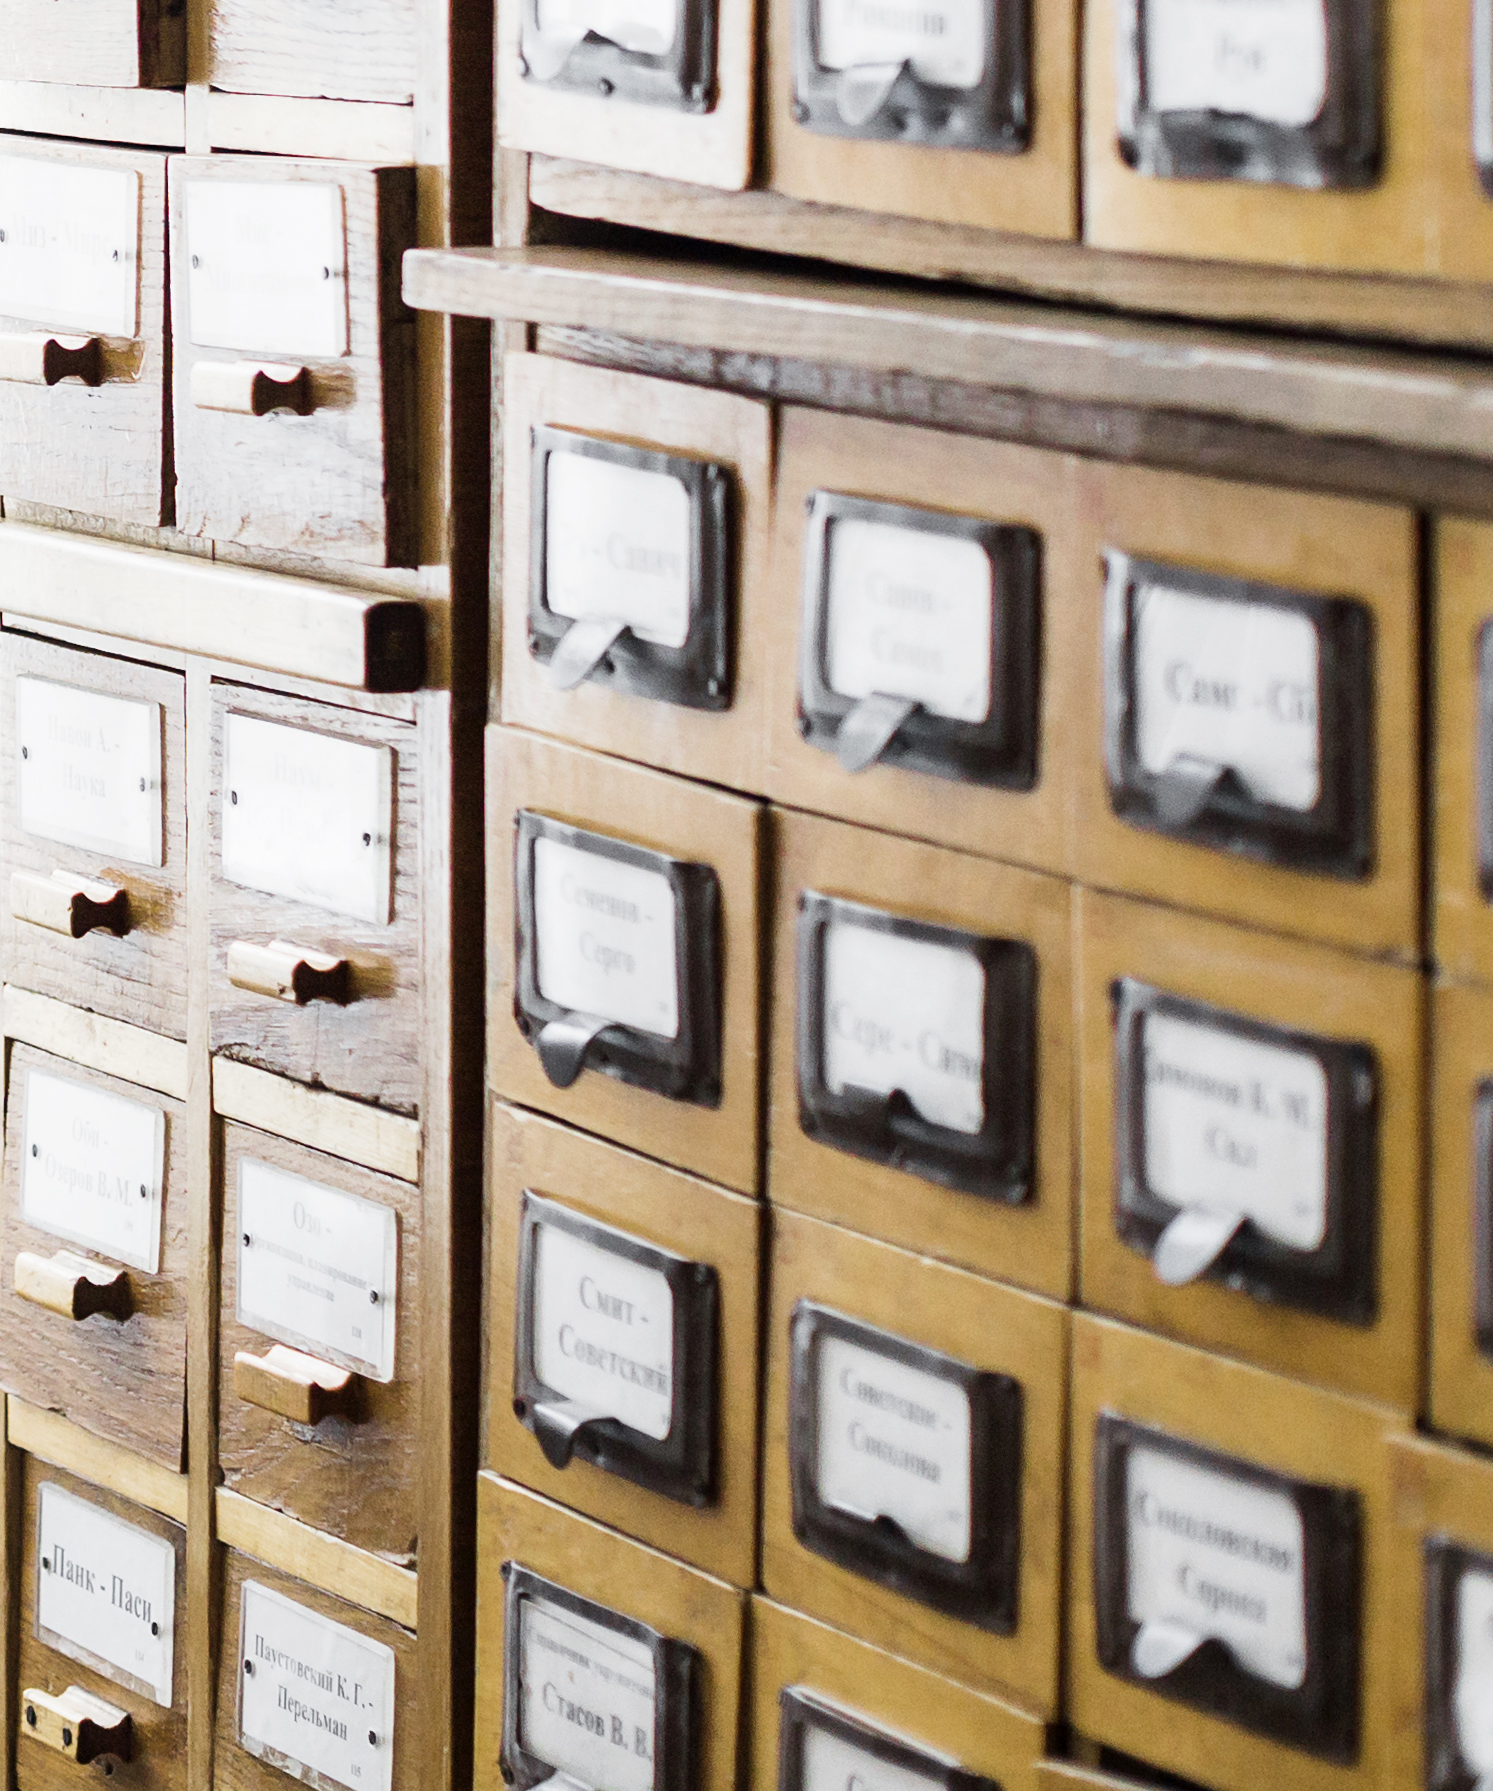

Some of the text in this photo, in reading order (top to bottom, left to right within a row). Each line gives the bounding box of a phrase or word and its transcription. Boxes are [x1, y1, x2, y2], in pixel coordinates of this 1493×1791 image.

[45, 1151, 94, 1194] Озеров
[579, 1275, 634, 1326] Смит
[52, 1543, 95, 1595] Панк
[111, 1574, 152, 1624] Паси
[254, 1633, 333, 1693] Паустовский
[337, 1674, 350, 1701] К.
[278, 1684, 347, 1741] Перельман
[542, 1681, 606, 1738] Стасов
[611, 1714, 628, 1750] В.
